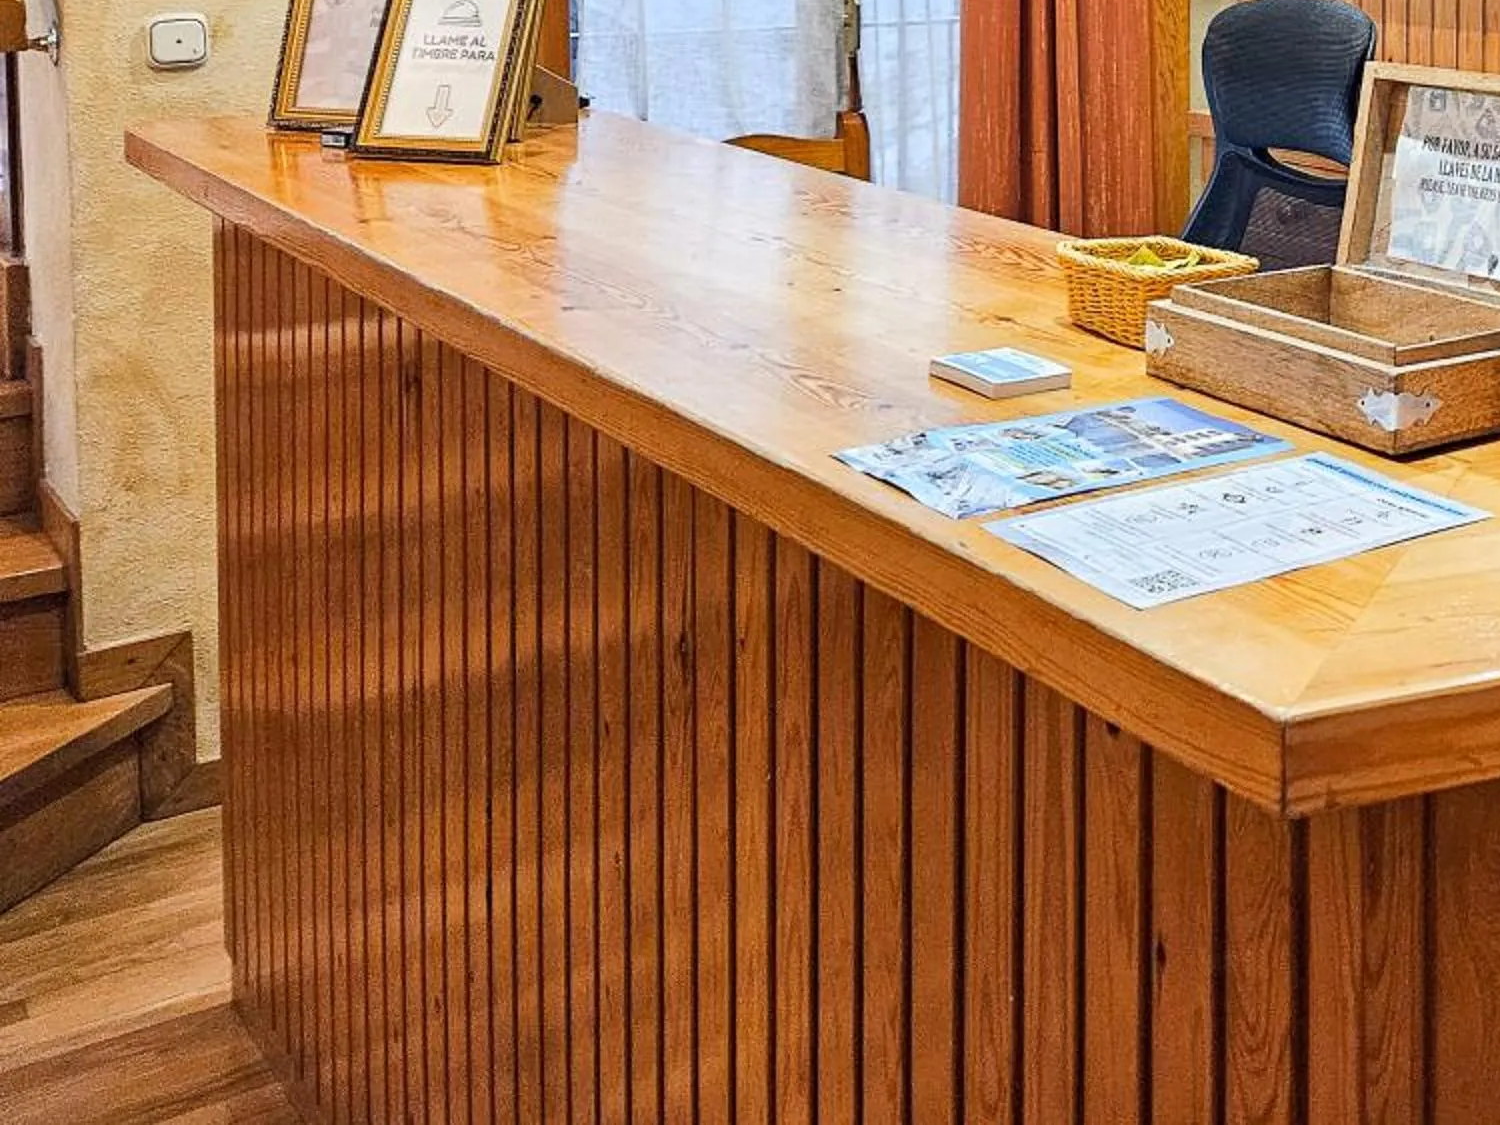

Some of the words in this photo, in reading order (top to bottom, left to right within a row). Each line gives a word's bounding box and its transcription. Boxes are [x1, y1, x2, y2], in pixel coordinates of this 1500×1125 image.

[423, 33, 468, 46] LLAME
[470, 35, 486, 47] AL
[412, 47, 458, 60] TIMBRE
[460, 48, 495, 60] PARA
[1439, 159, 1470, 178] LLAVES
[1470, 164, 1482, 180] DE
[1482, 165, 1493, 182] LA
